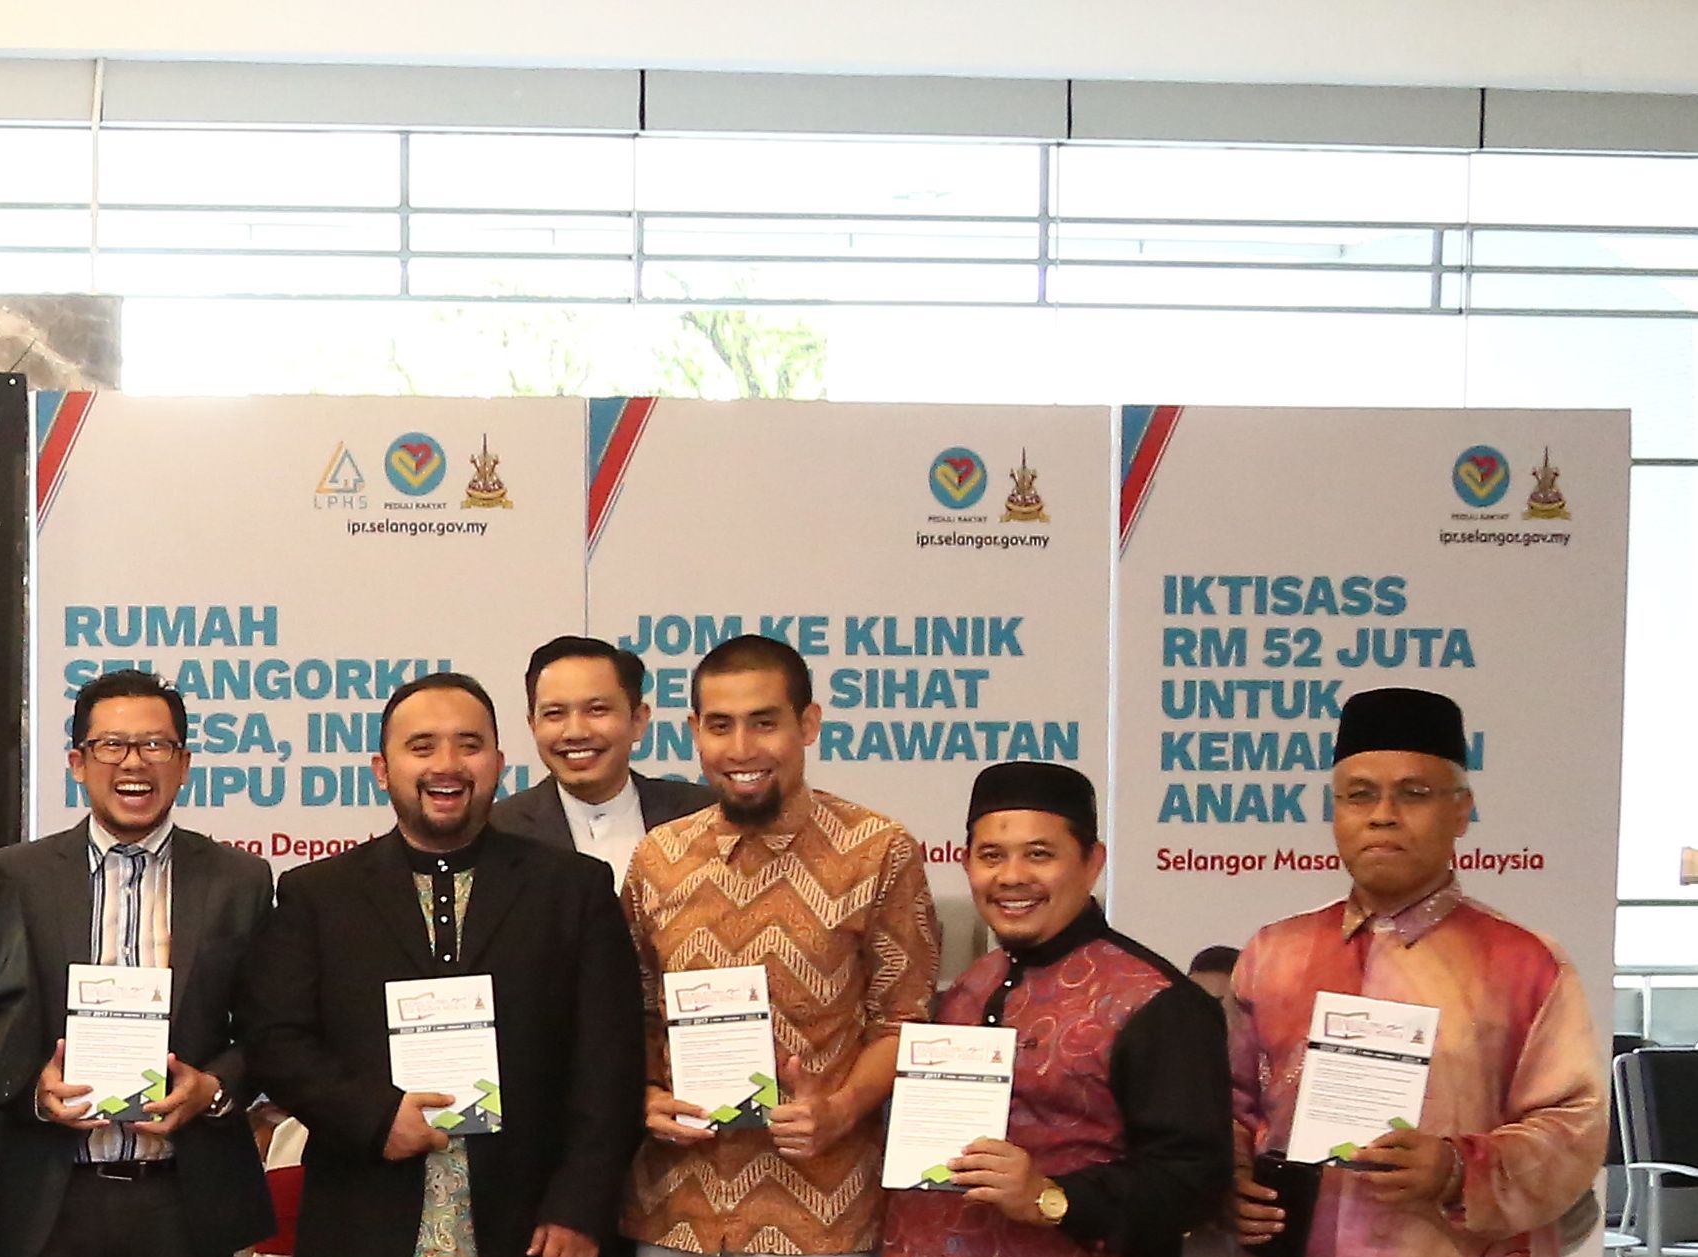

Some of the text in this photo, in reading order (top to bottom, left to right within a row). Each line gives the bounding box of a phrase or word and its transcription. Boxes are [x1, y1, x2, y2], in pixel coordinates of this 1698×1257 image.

[314, 496, 368, 510] LPHS
[347, 519, 488, 536] ipr.selangor.gov.my
[916, 531, 1050, 549] ipr.selangor.gov.my
[1440, 529, 1571, 546] ipr.selangor.gov.my
[1163, 575, 1408, 616] IKTISASS
[64, 605, 278, 646] RUMAH
[618, 615, 741, 657] JOM
[844, 616, 1024, 657] KLINIK
[1162, 627, 1476, 668] RM 52 JUTA
[829, 668, 989, 709] SIHAT
[1160, 679, 1343, 719] UNTUK
[819, 721, 1079, 761] RAWATAN
[1157, 783, 1307, 823] ANAK
[1156, 848, 1267, 875] Selangor
[1274, 849, 1340, 871] Masa
